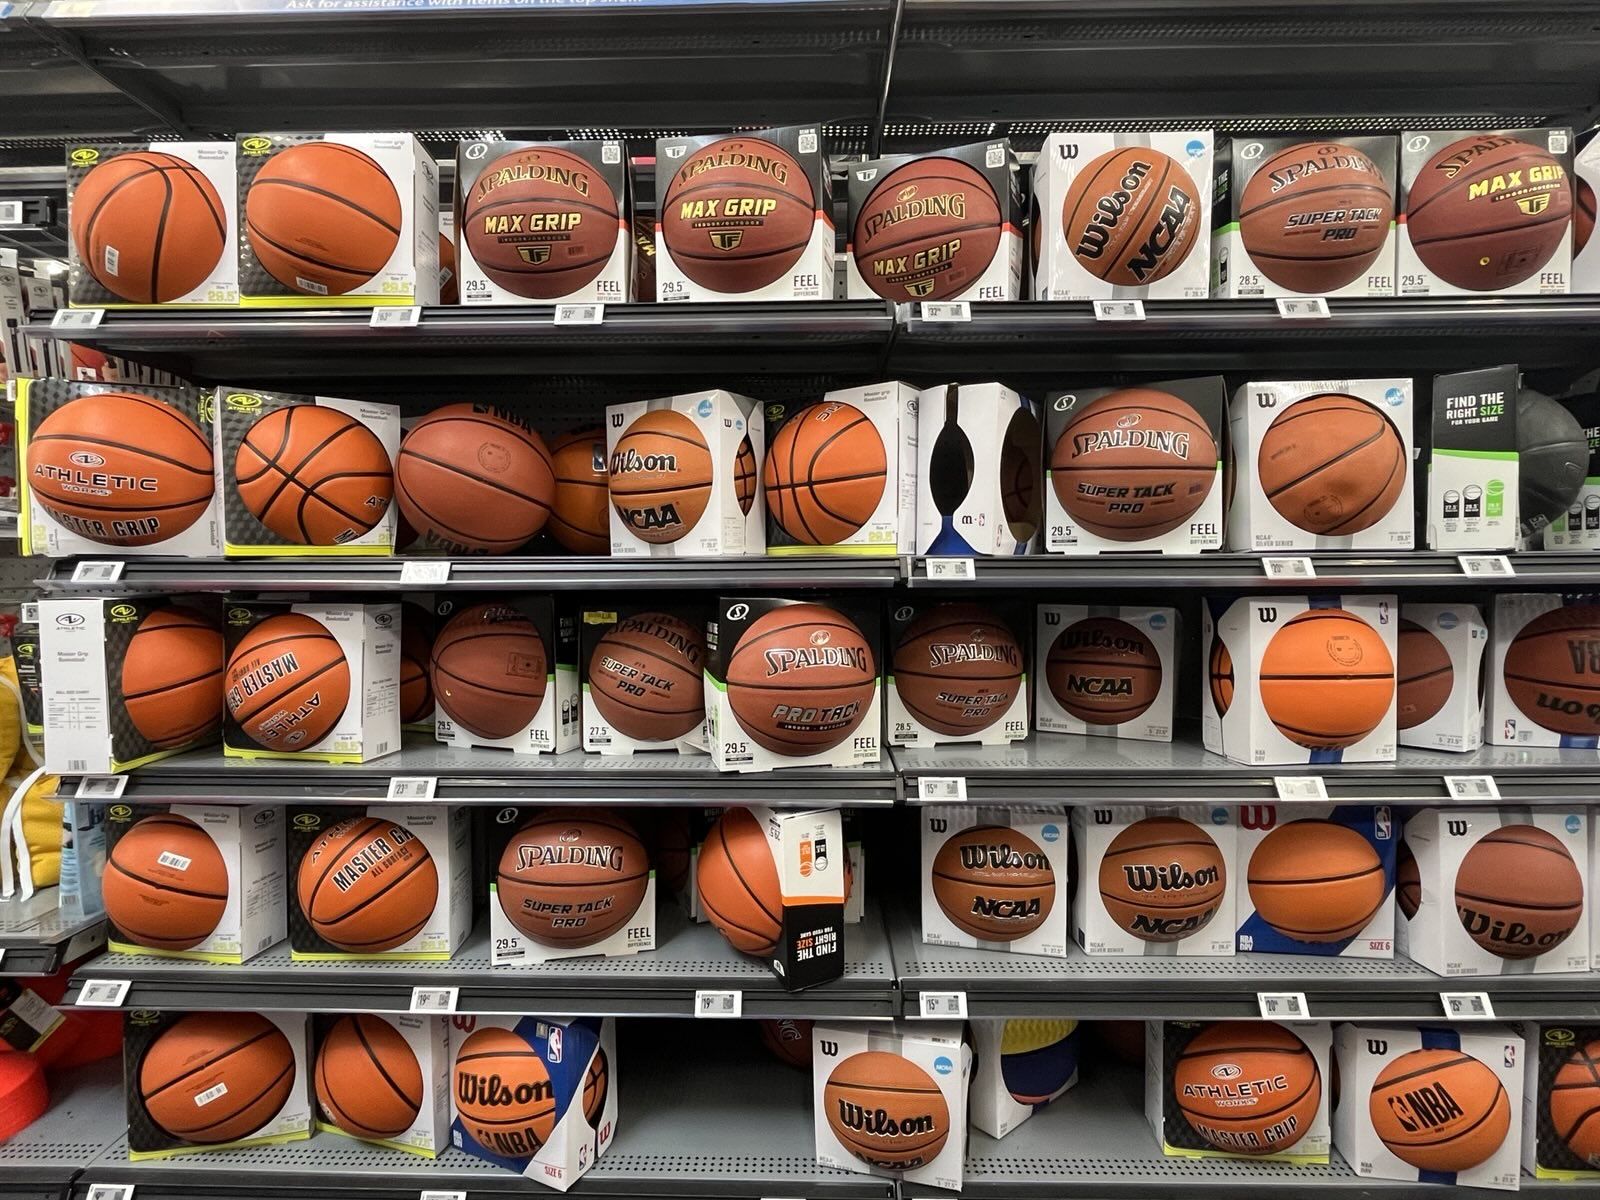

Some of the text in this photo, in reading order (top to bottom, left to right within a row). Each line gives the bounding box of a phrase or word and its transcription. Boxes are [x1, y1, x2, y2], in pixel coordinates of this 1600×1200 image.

[287, 0, 313, 8] Ask
[318, 0, 337, 8] for
[679, 153, 788, 187] SPALDING
[478, 164, 590, 202] SPALDING
[1468, 165, 1565, 201] MAX GRIP
[681, 199, 778, 220] MAX GRIP
[864, 192, 966, 243] SPALDING
[1076, 160, 1152, 260] Wilson
[1285, 207, 1383, 228] SUPER TACK
[485, 212, 582, 234] MAX GRIP
[1321, 226, 1358, 241] PRO
[1126, 186, 1190, 282] NCAA
[873, 238, 962, 276] MAX GRIP
[597, 281, 620, 292] FEEL
[793, 275, 819, 287] FEEL
[1367, 276, 1393, 288] FEEL
[1540, 272, 1565, 284] FEEL
[979, 286, 1004, 298] FEEL
[1446, 392, 1505, 410] FIND THE
[1446, 405, 1504, 420] RIGHT SIZE
[1072, 430, 1189, 460] SPALDING
[610, 449, 677, 476] Wilson
[34, 464, 158, 492] ATHLETIC
[61, 483, 112, 496] WORKS
[1078, 482, 1176, 497] SUPER TACK
[1107, 501, 1144, 514] PRO
[112, 517, 161, 537] GRIP
[1189, 524, 1217, 535] FEEL
[611, 621, 699, 665] SPALDING
[1061, 630, 1144, 654] Wilson
[764, 648, 867, 677] SPALDING
[929, 643, 1017, 668] SPALDING
[242, 651, 299, 697] MASTER
[600, 656, 675, 691] SUPER TACK
[617, 680, 646, 697] PRO
[1066, 674, 1134, 696] NCAA
[936, 692, 983, 705] SUPER
[262, 692, 321, 741] ATHLE
[773, 701, 862, 724] PRO TACK
[962, 707, 991, 717] PRO
[530, 729, 549, 740] FEEL
[1005, 721, 1024, 731] FEEL
[854, 738, 877, 749] FEEL
[333, 837, 392, 892] MASTER
[516, 846, 623, 871] SPALDING
[960, 843, 1050, 870] Wilson
[371, 866, 384, 878] ALL
[1123, 862, 1219, 892] Wilson
[523, 897, 614, 914] SUPER TACK
[970, 896, 1041, 919] NCAA
[552, 917, 587, 928] PRO
[628, 928, 651, 939] FEEL
[796, 932, 837, 949] RIGHT SIZE
[797, 942, 837, 962] FIND THE
[1369, 941, 1391, 950] SIZE 6
[458, 1071, 554, 1106] Wilson
[1183, 1075, 1288, 1098] ATHLETIC
[1215, 1097, 1258, 1107] WORKS
[1404, 1081, 1464, 1129] NBA
[838, 1098, 935, 1137] Wilson
[493, 1127, 543, 1154] NBA
[1198, 1115, 1298, 1147] MASTER GRIP
[544, 1166, 563, 1179] SIZE 6
